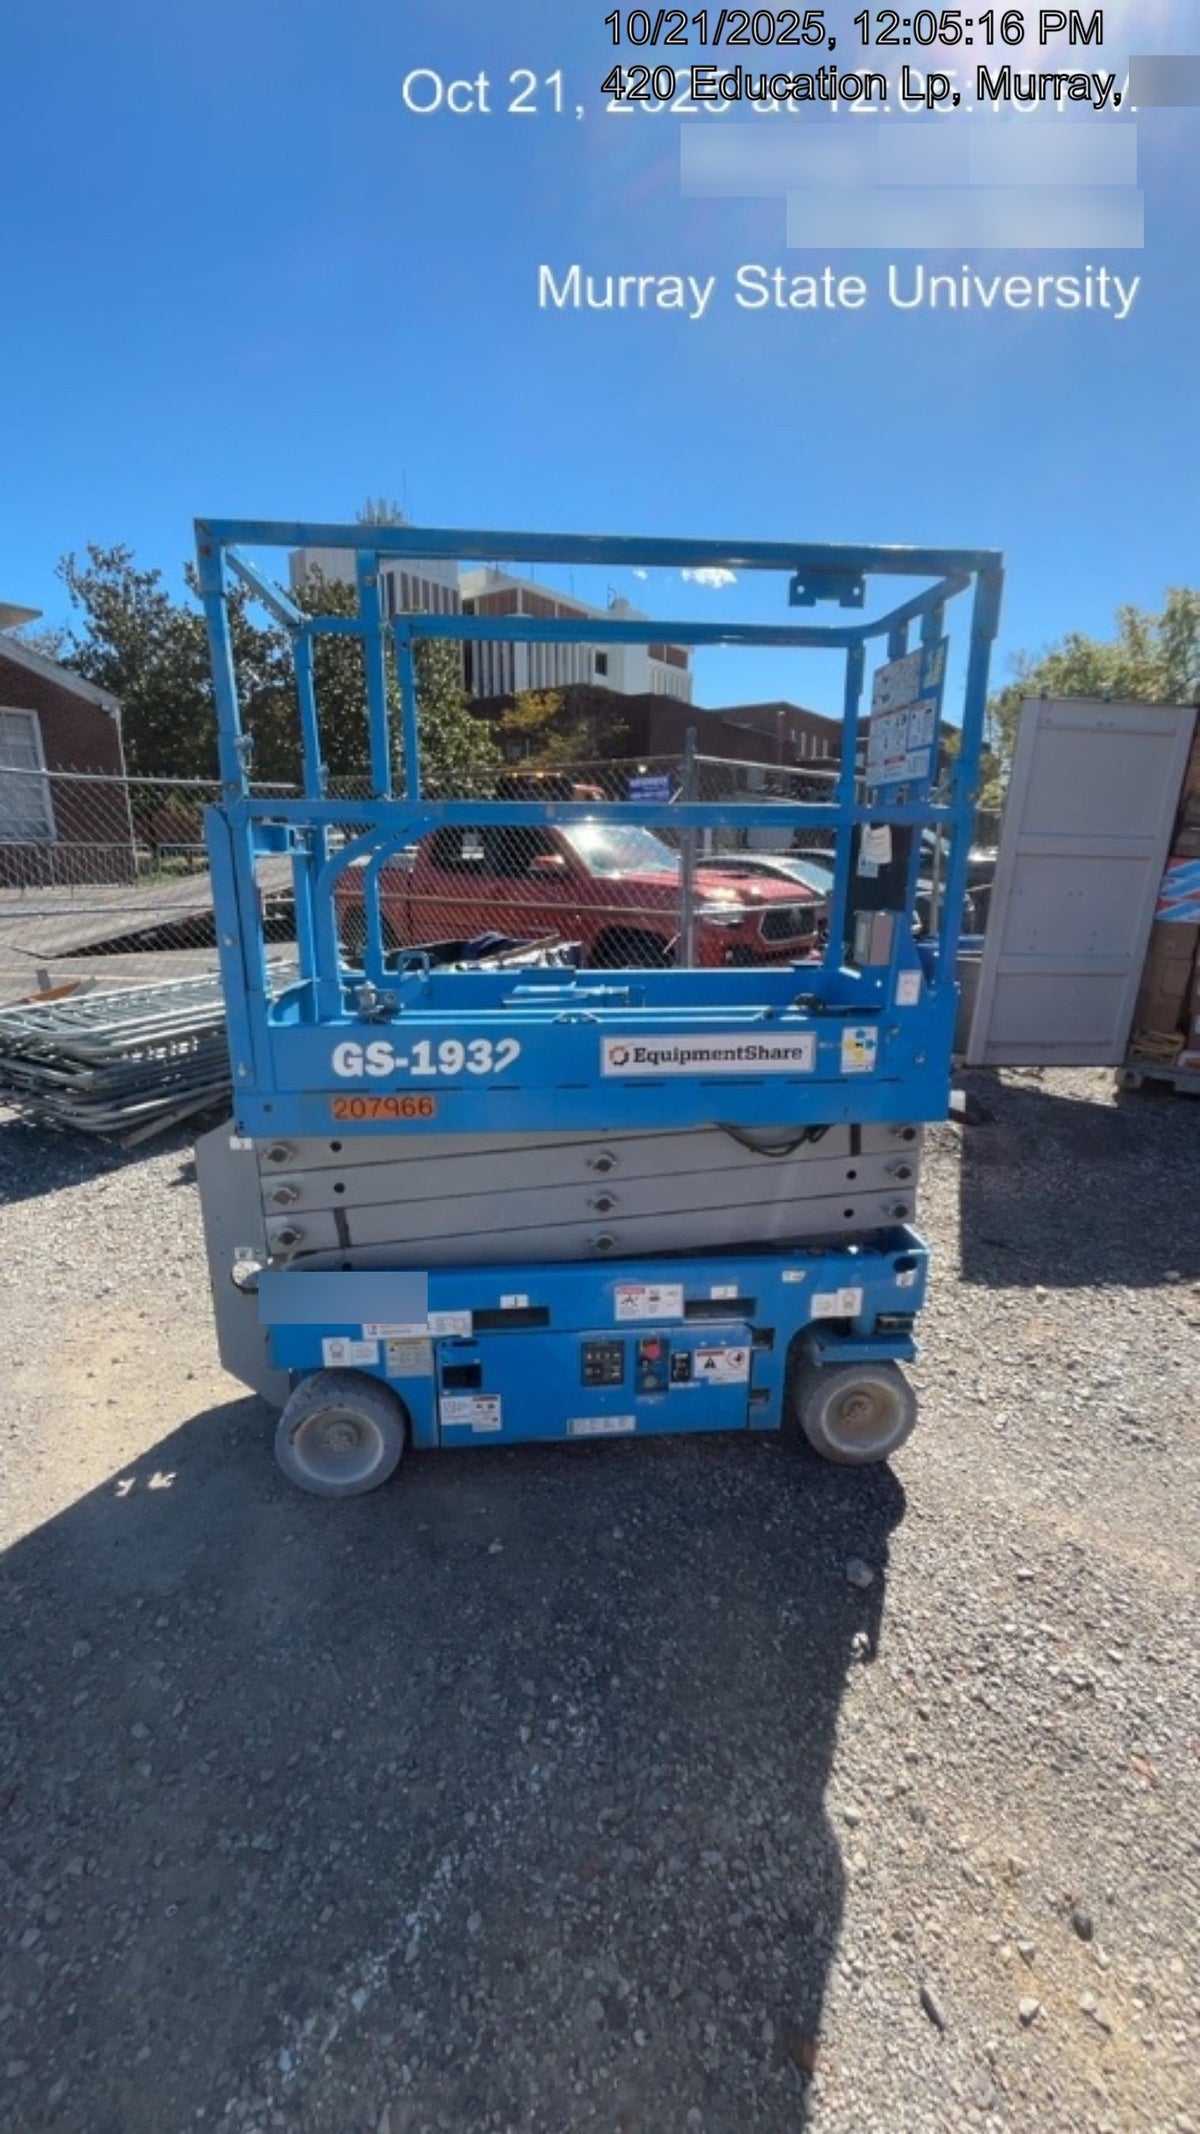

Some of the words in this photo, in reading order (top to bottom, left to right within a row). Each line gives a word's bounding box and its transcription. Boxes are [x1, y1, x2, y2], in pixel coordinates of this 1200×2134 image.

[332, 1038, 521, 1077] GS-1932
[632, 1045, 804, 1066] EquipmentShare
[333, 1096, 434, 1120] 207966
